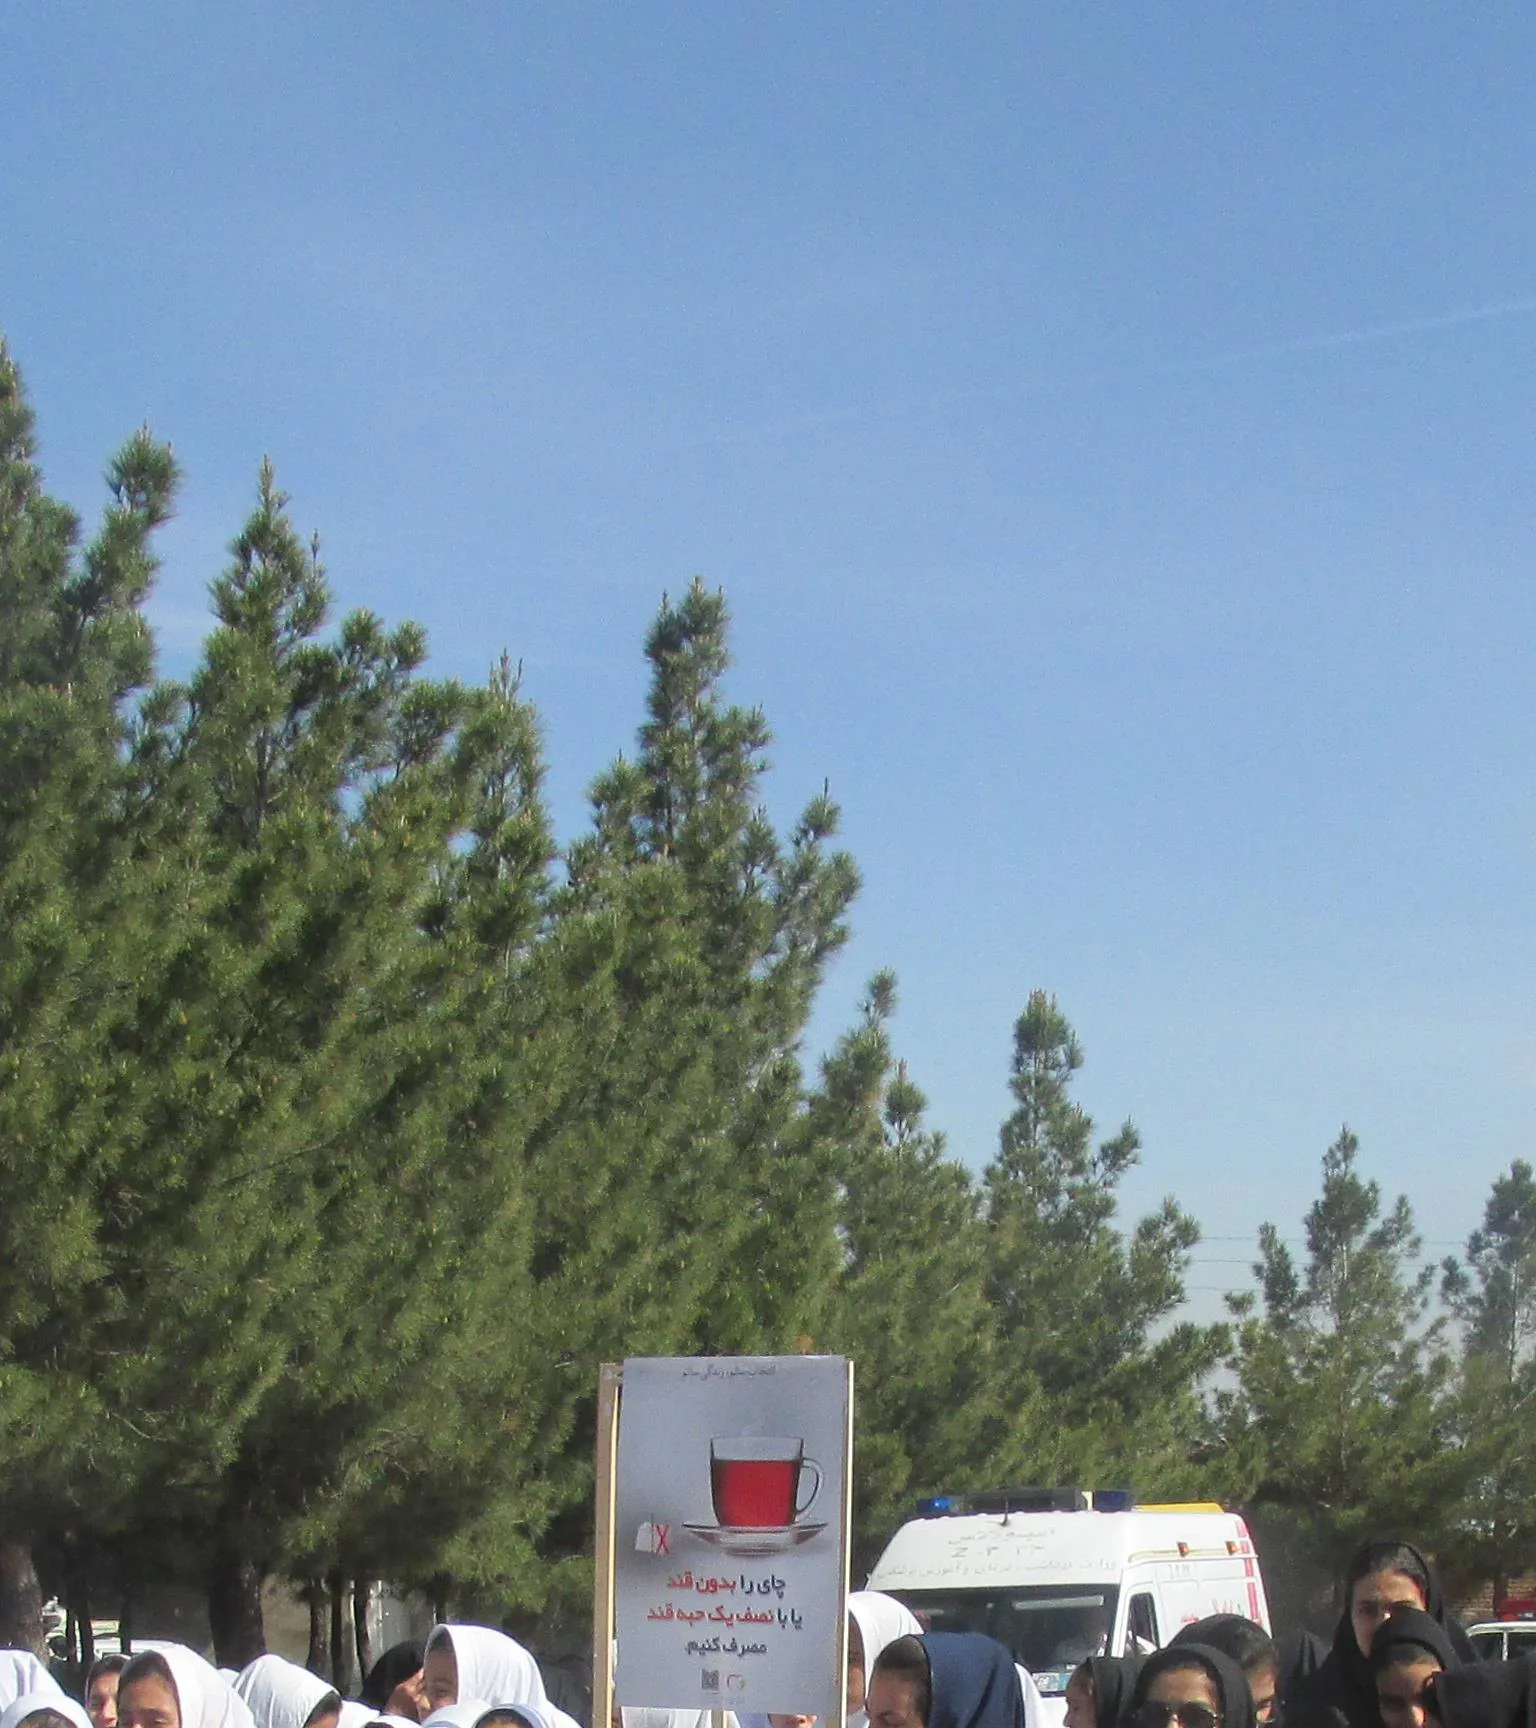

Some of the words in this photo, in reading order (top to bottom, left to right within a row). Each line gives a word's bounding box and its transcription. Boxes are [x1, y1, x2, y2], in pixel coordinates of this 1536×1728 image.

[667, 1571, 693, 1589] قند
[696, 1575, 737, 1595] بدون
[740, 1574, 754, 1595] را
[757, 1574, 786, 1599] چای
[647, 1602, 674, 1622] قند
[676, 1607, 705, 1627] حبه
[708, 1604, 735, 1628] یک
[736, 1606, 775, 1624] نصف
[777, 1608, 788, 1629] با
[791, 1608, 803, 1630] یا
[723, 1637, 768, 1657] مصرف
